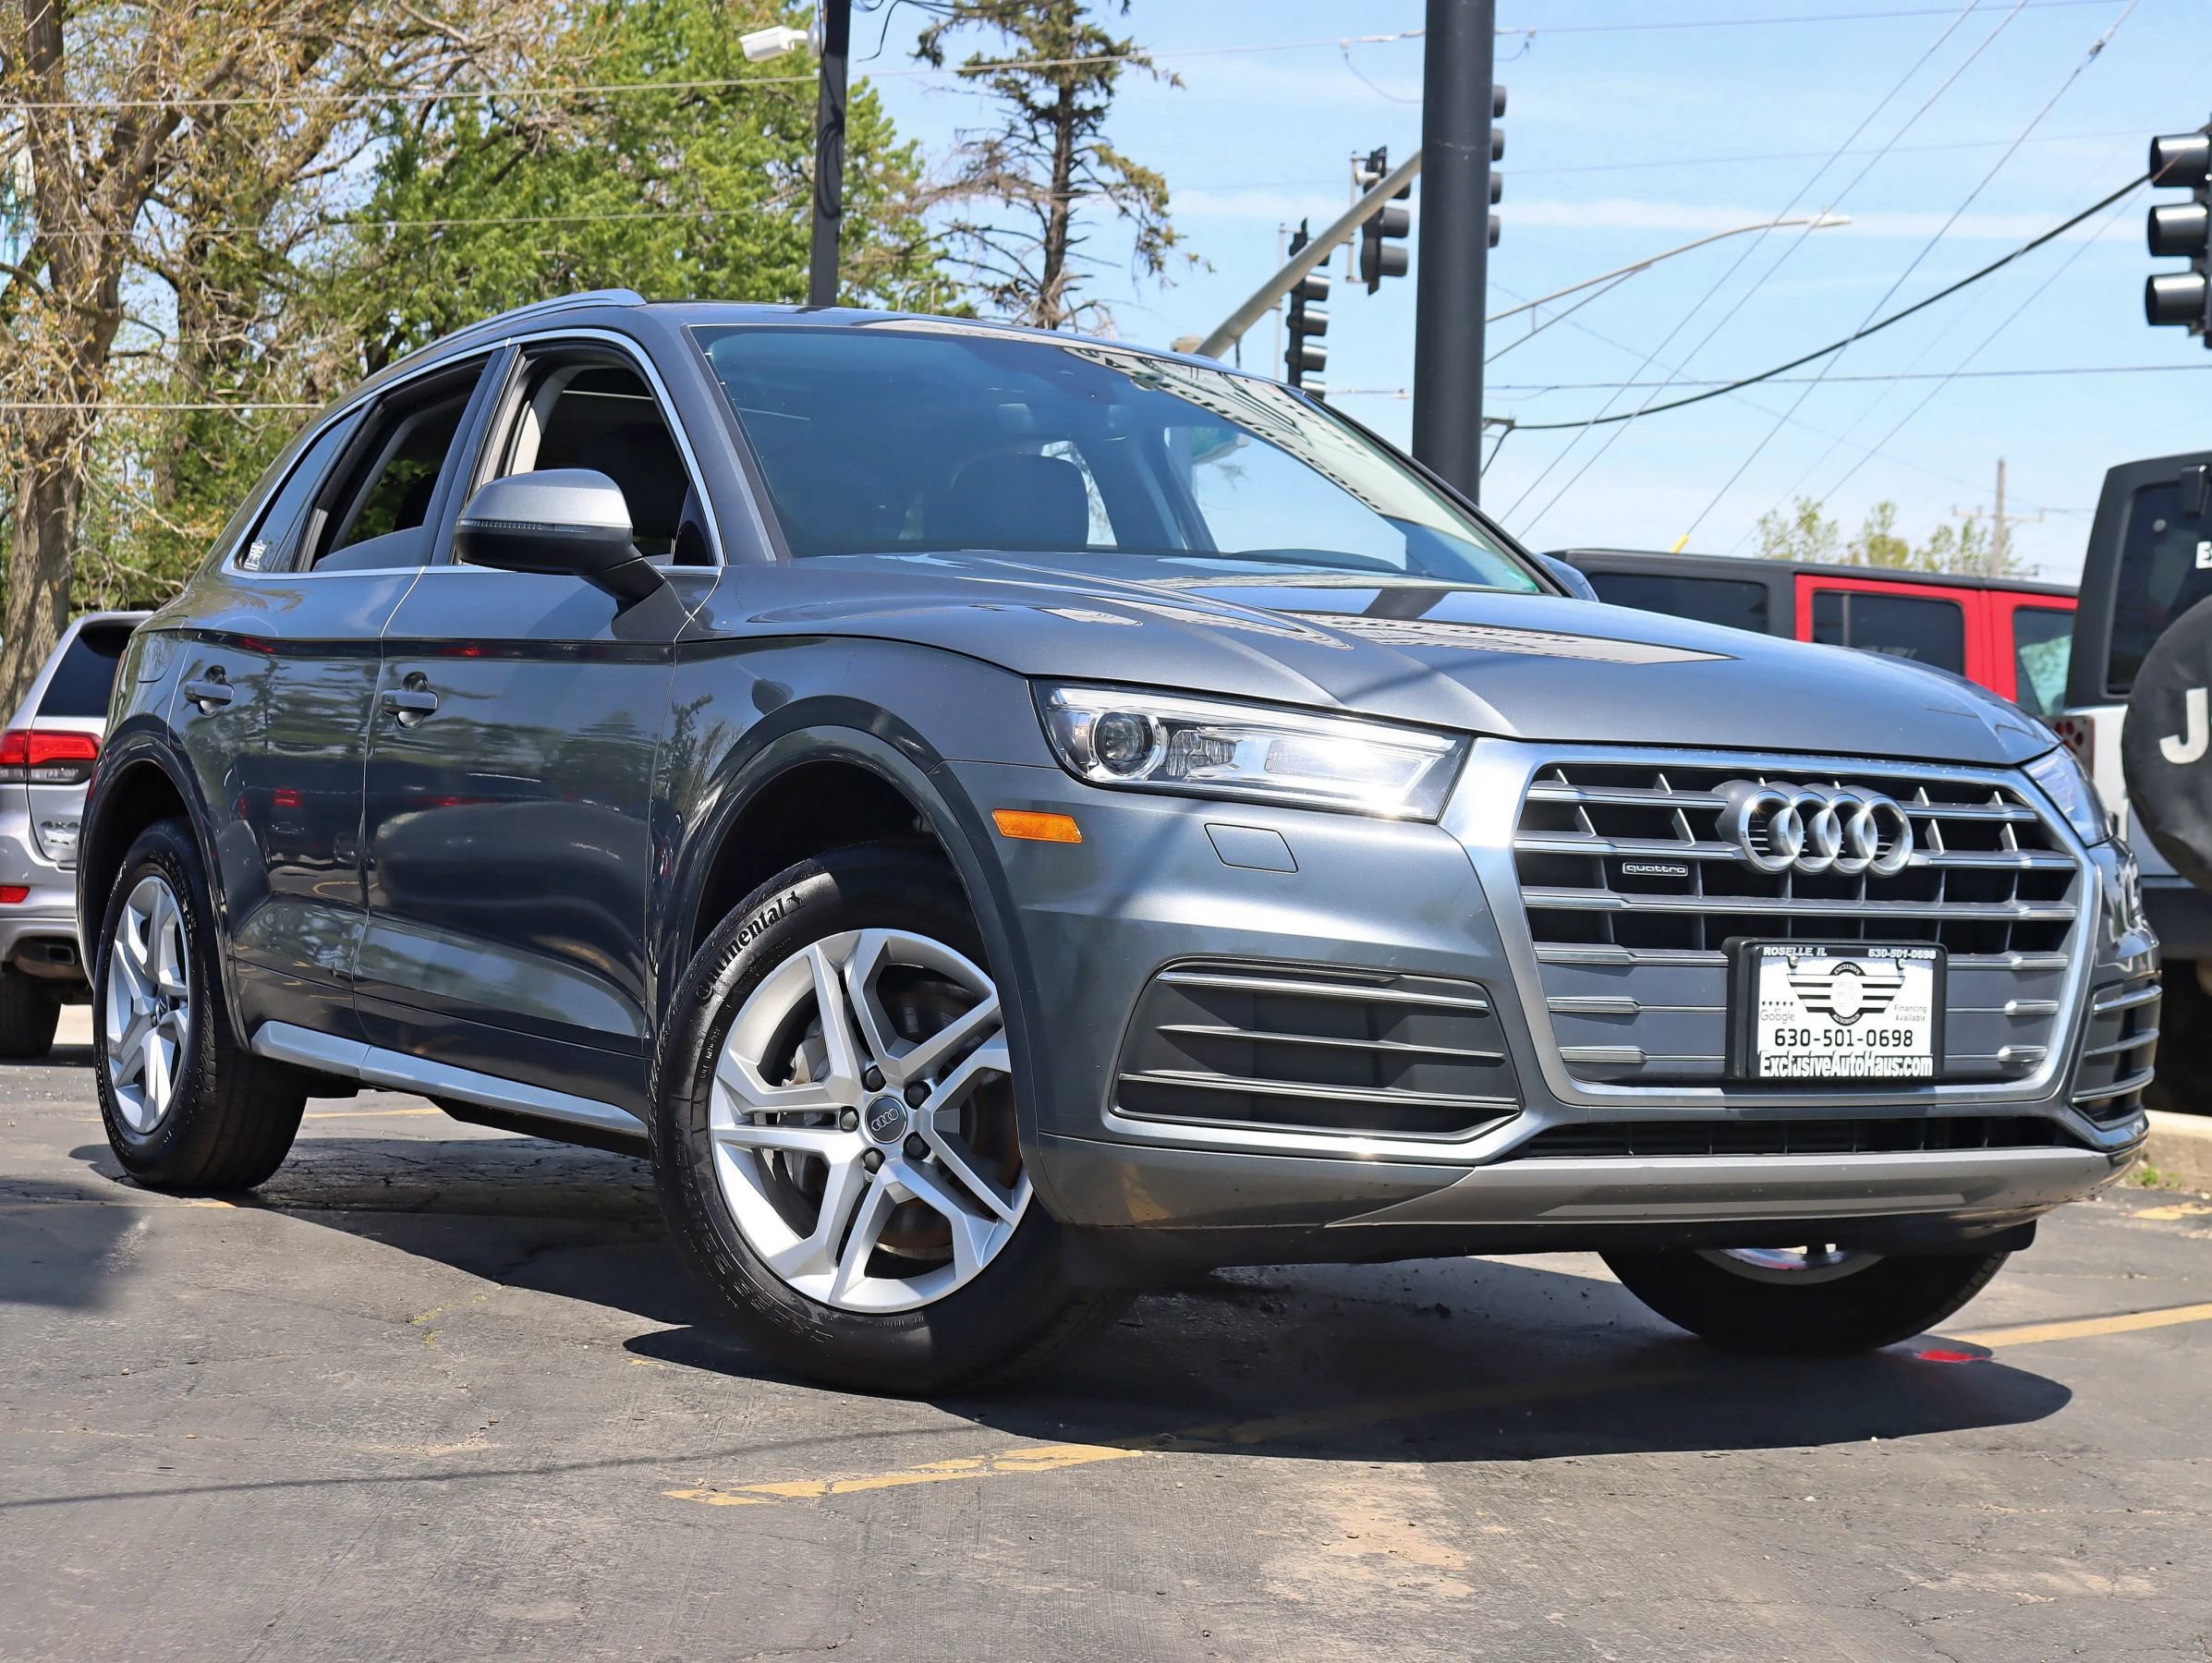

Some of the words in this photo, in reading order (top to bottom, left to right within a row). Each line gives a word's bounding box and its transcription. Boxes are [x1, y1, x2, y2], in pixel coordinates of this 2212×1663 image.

[2159, 686, 2212, 764] J
[1626, 865, 1686, 873] quattro
[696, 897, 788, 1005] Continental
[1816, 947, 1828, 956] IL
[1868, 949, 1937, 960] 630-501-0698
[1760, 1009, 1795, 1024] Google
[1774, 1028, 1914, 1048] 630-501-0698
[1759, 1050, 1933, 1076] ExclusiveAutoHaus.com
